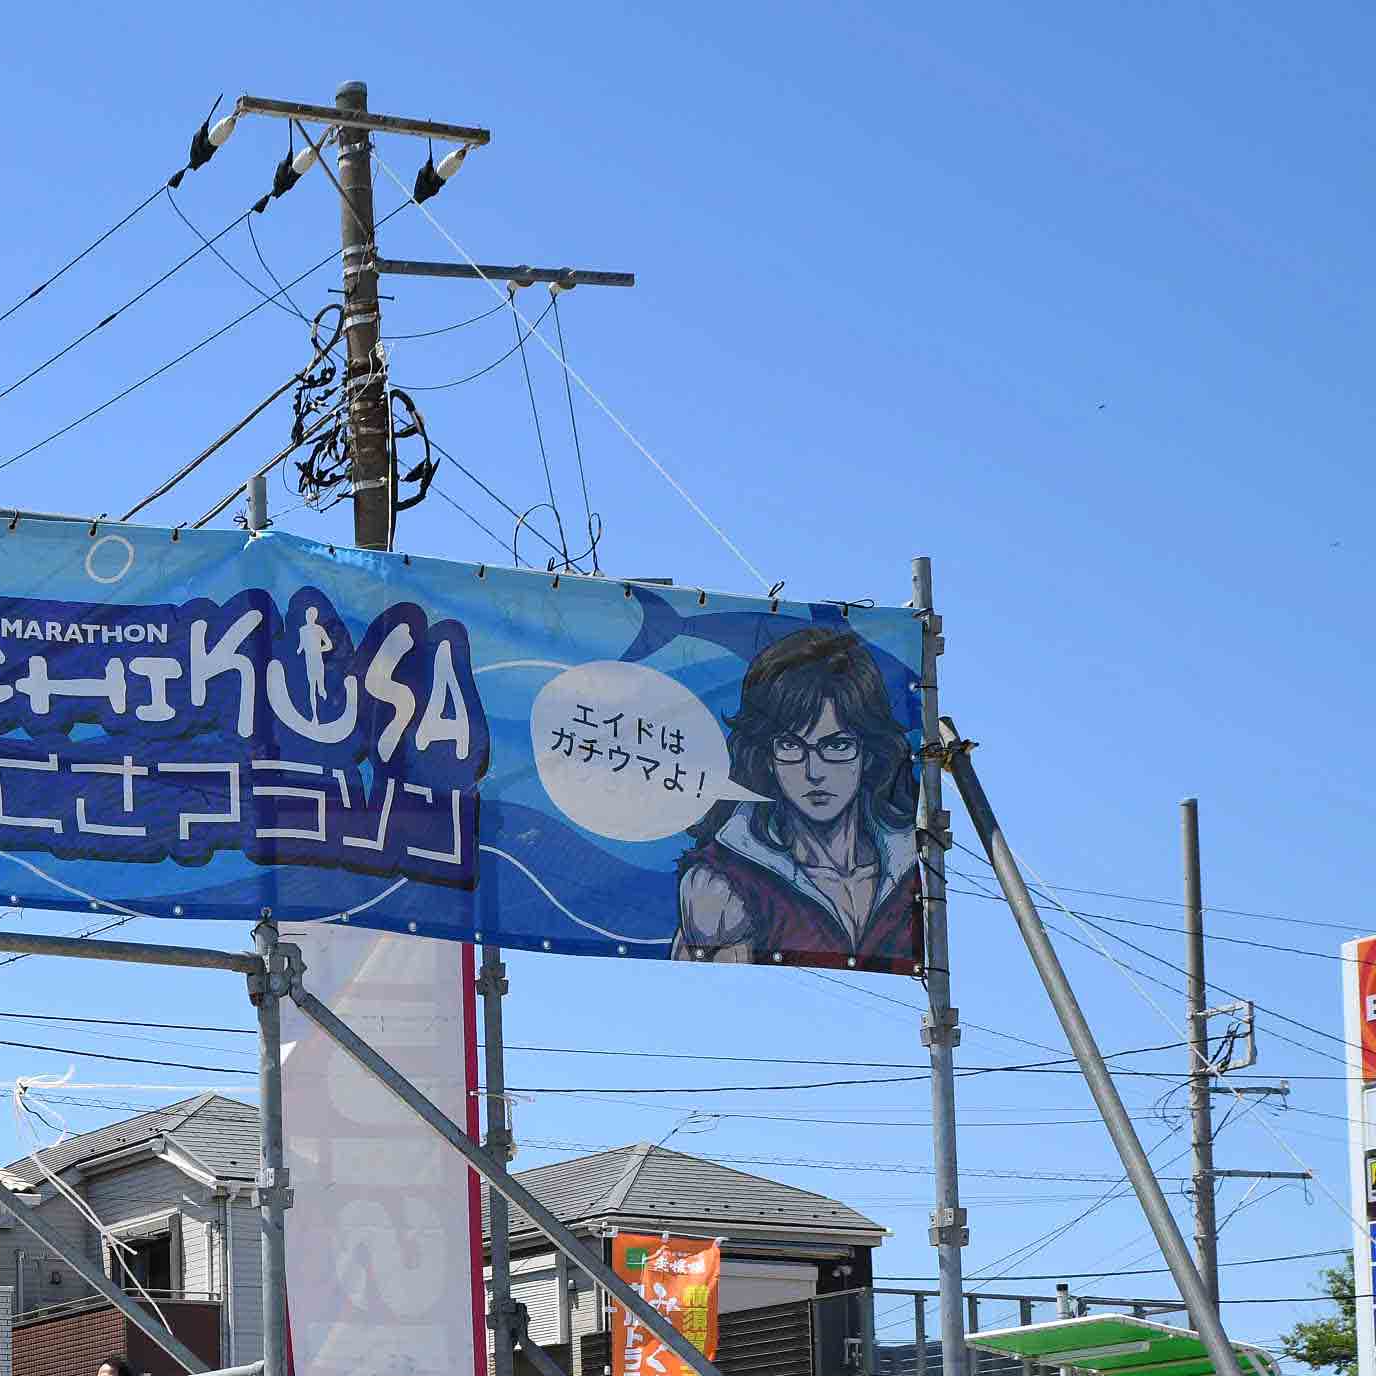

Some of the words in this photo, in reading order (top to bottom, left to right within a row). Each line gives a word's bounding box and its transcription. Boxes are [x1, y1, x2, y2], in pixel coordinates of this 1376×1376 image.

[1, 614, 169, 646] MARATHON
[570, 700, 686, 756] エイドは
